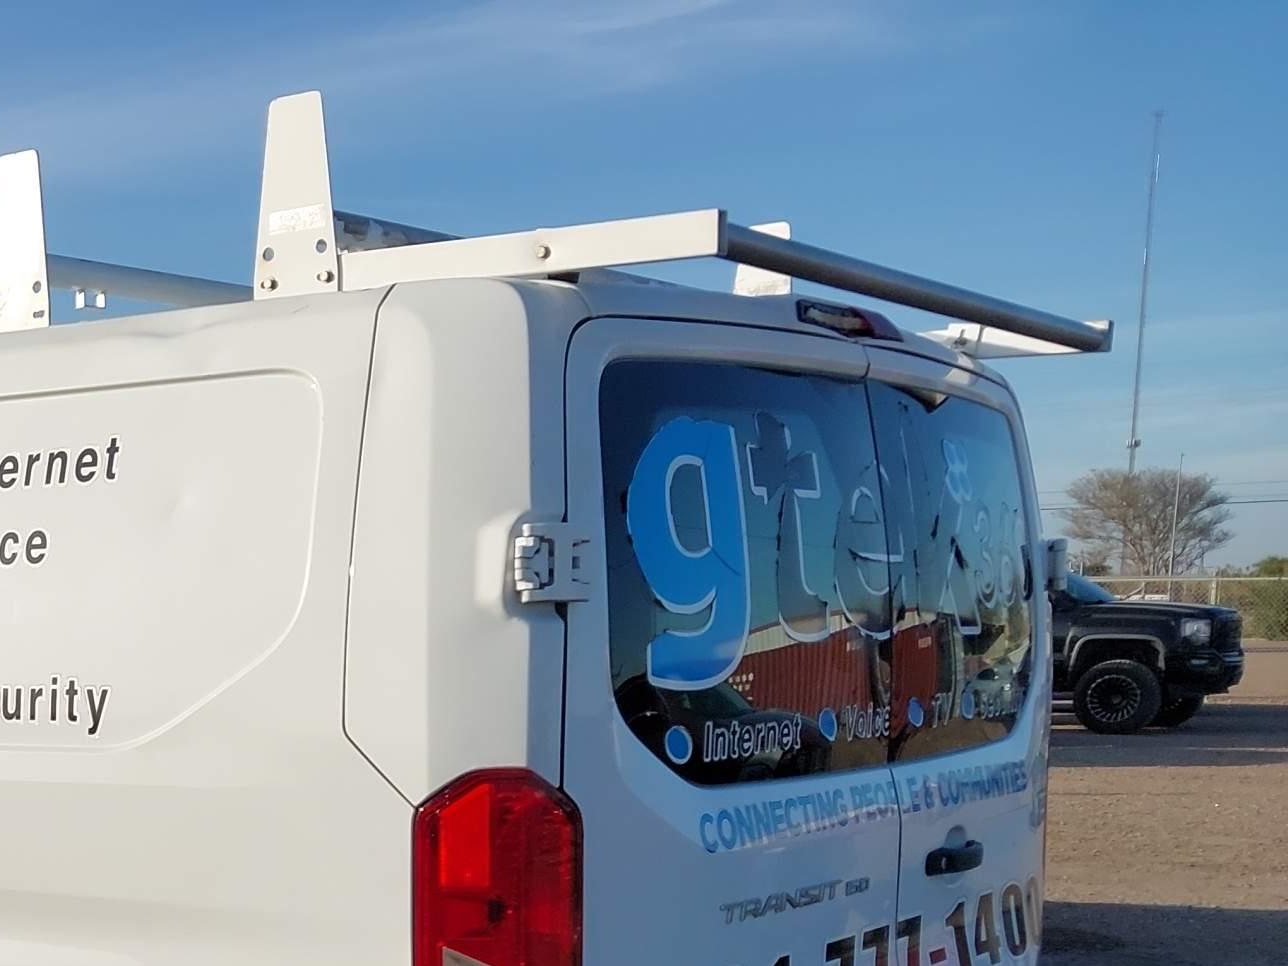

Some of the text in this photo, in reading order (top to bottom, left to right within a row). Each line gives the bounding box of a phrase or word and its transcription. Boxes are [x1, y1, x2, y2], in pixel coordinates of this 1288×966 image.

[703, 712, 802, 763] Internet
[844, 702, 890, 742] Voice
[698, 787, 847, 854] CONNECTING
[848, 773, 921, 824] PEOPLE
[719, 879, 843, 925] TRANSIT
